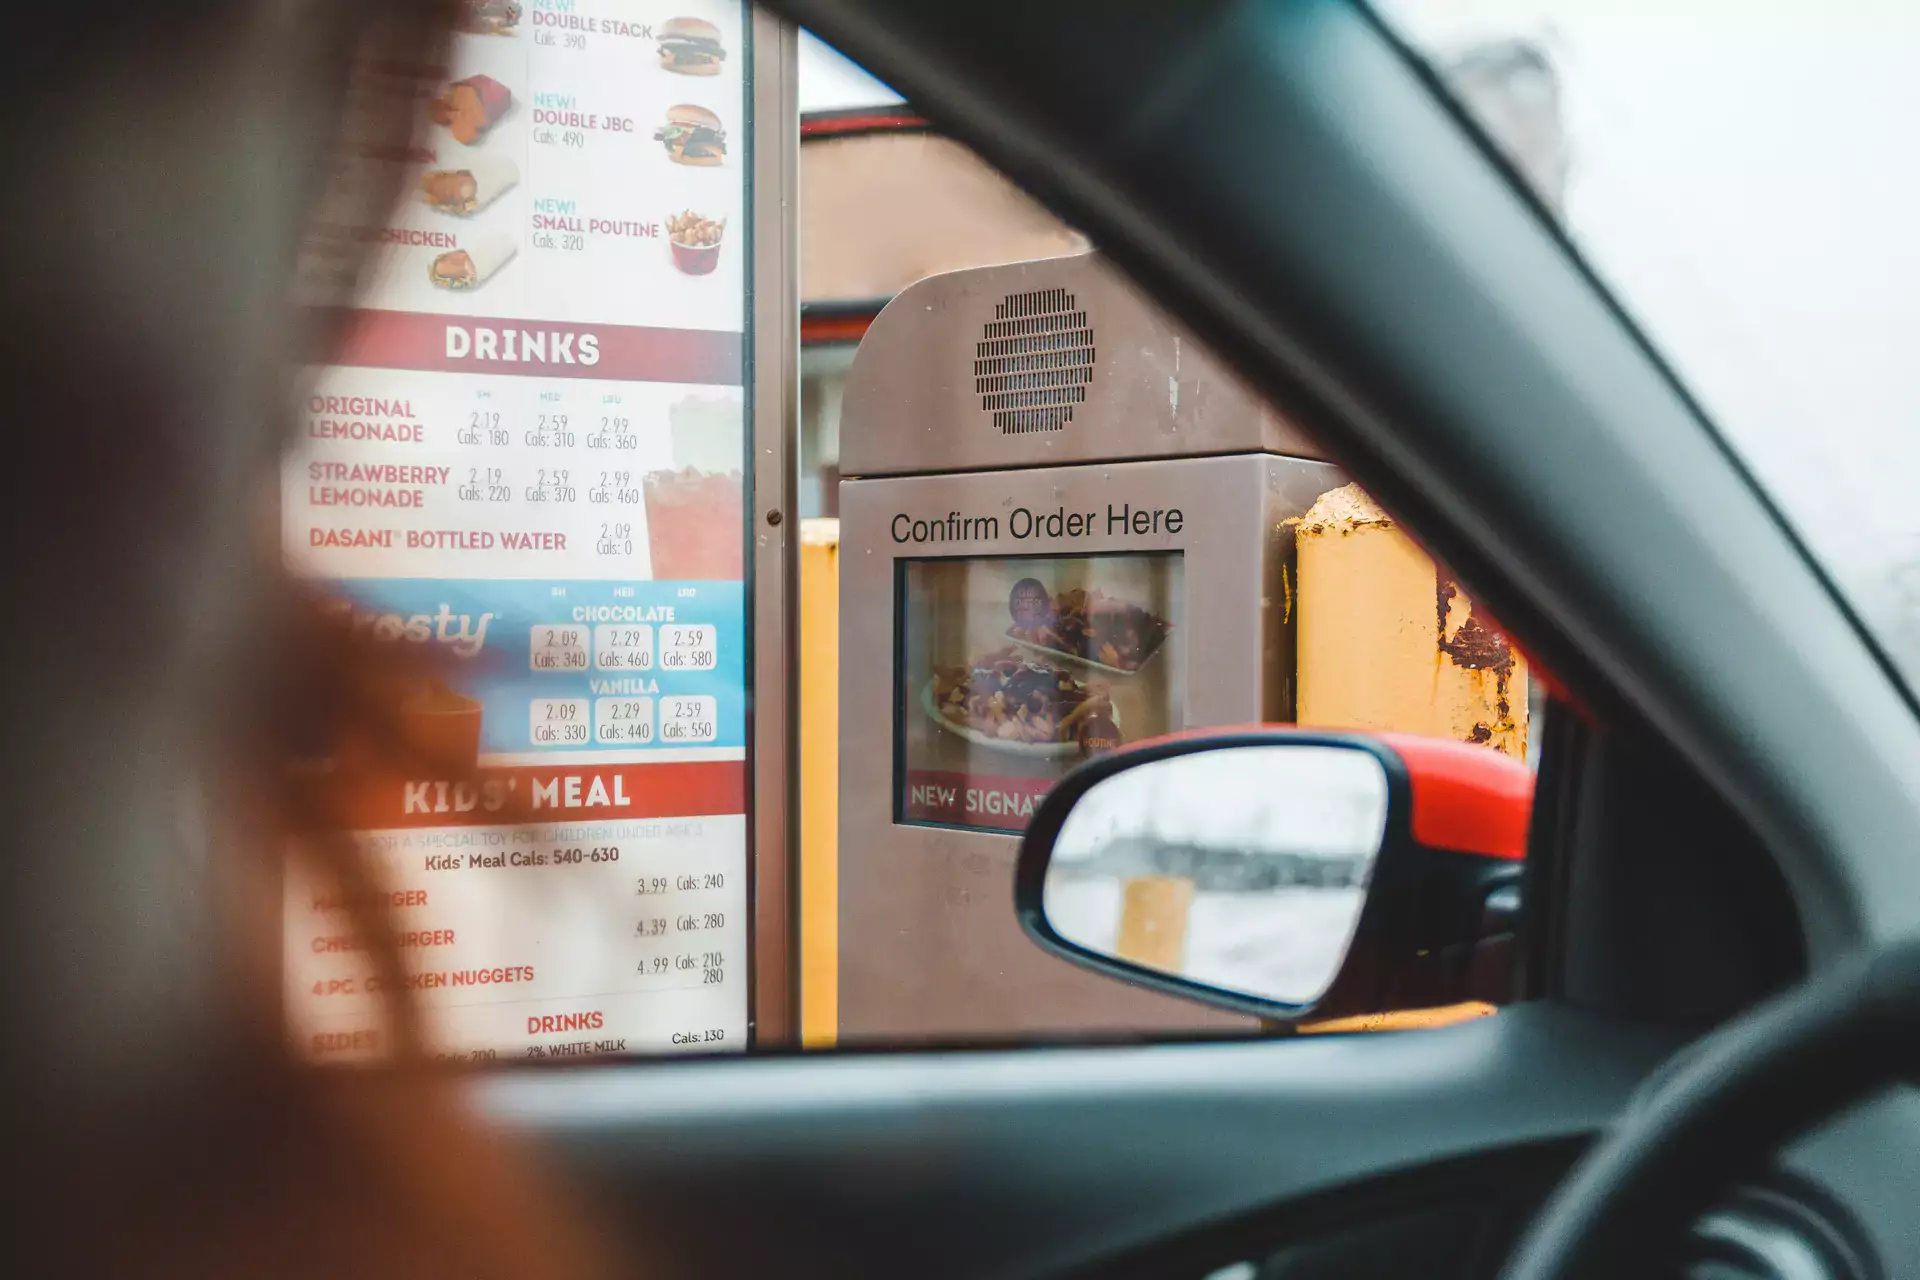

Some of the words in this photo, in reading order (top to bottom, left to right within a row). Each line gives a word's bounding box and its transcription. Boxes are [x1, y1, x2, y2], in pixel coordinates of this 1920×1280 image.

[533, 10, 597, 32] DOUBLE
[601, 20, 653, 39] STACK
[563, 33, 586, 50] 390
[534, 91, 576, 109] NEW!
[533, 109, 597, 129] DOUBLE
[602, 116, 634, 132] JBC
[562, 131, 584, 148] 490
[534, 199, 576, 214] NEW!
[533, 214, 585, 232] SMALL
[589, 218, 660, 238] POUTINE
[533, 232, 557, 249] Cals:
[562, 235, 584, 251] 320
[446, 325, 601, 367] DRINKS
[308, 396, 416, 418] ORIGINAL
[472, 411, 500, 429] 2.19
[538, 414, 568, 431] 2.59
[602, 416, 629, 433] 2.99
[309, 420, 424, 442] LEMONADE
[457, 428, 482, 445] Cals:
[489, 429, 509, 446] 180
[525, 430, 550, 447] Cals:
[554, 432, 575, 448] 310
[587, 432, 611, 449] Cals:
[615, 434, 637, 450] 360
[309, 461, 451, 485] STRAWBERRY
[538, 469, 569, 486] 2.59
[600, 471, 630, 488] 2.99
[309, 486, 424, 508] LEMONADE
[458, 484, 483, 501] Cals:
[489, 485, 511, 502] 220
[525, 486, 550, 502] Cals:
[554, 487, 576, 503] 370
[588, 487, 612, 503] Cals:
[617, 488, 639, 504] 460
[601, 523, 631, 539] 2.09
[891, 512, 999, 543] Confirm
[1009, 507, 1096, 539] Order
[1107, 504, 1184, 535] Here
[406, 530, 495, 550] BOTTLED
[501, 532, 567, 550] WATER
[596, 539, 621, 555] Cals:
[624, 540, 632, 555] 0
[572, 605, 676, 622] CHOCOLATE
[547, 630, 578, 647] 2.09
[610, 630, 640, 647] 2.29
[674, 630, 703, 647] 2.59
[534, 652, 560, 668] Cals:
[564, 652, 586, 667] 340
[599, 652, 623, 667] Cals:
[627, 652, 649, 667] 460
[663, 651, 687, 667] Cals:
[691, 651, 712, 666] 580
[589, 677, 660, 695] VANILLA
[546, 703, 576, 720] 2.09
[611, 702, 640, 720] 2.29
[675, 702, 701, 718] 2.59
[535, 725, 560, 741] Cals:
[564, 725, 586, 741] 330
[599, 724, 624, 740] Cals:
[627, 723, 650, 739] 440
[663, 722, 687, 738] Cals:
[691, 722, 712, 738] 550
[404, 777, 517, 814] KIDS'
[532, 774, 631, 809] MEAL
[911, 785, 957, 807] NEW
[419, 833, 476, 848] SPECIAL
[481, 831, 508, 846] TOY
[544, 826, 612, 843] CHILDREN
[425, 854, 464, 871] Kids'
[469, 852, 506, 869] Meal
[510, 851, 549, 867] Cals:
[553, 847, 620, 865] 540-630
[637, 878, 667, 894] 3.99
[676, 875, 700, 891] Cals:
[704, 873, 724, 889] 240
[636, 918, 667, 936] 4.39
[676, 914, 700, 931] Cals:
[704, 913, 725, 929] 280
[637, 957, 669, 975] 4.99
[675, 953, 699, 970] Cals:
[452, 966, 535, 986] NUGGETS
[703, 968, 724, 985] 280
[527, 1011, 604, 1035] DRINKS
[672, 1032, 701, 1045] Cals:
[704, 1029, 724, 1042] 130
[526, 1046, 546, 1059] 2%
[549, 1041, 591, 1057] WHITE
[595, 1039, 626, 1052] MILK
